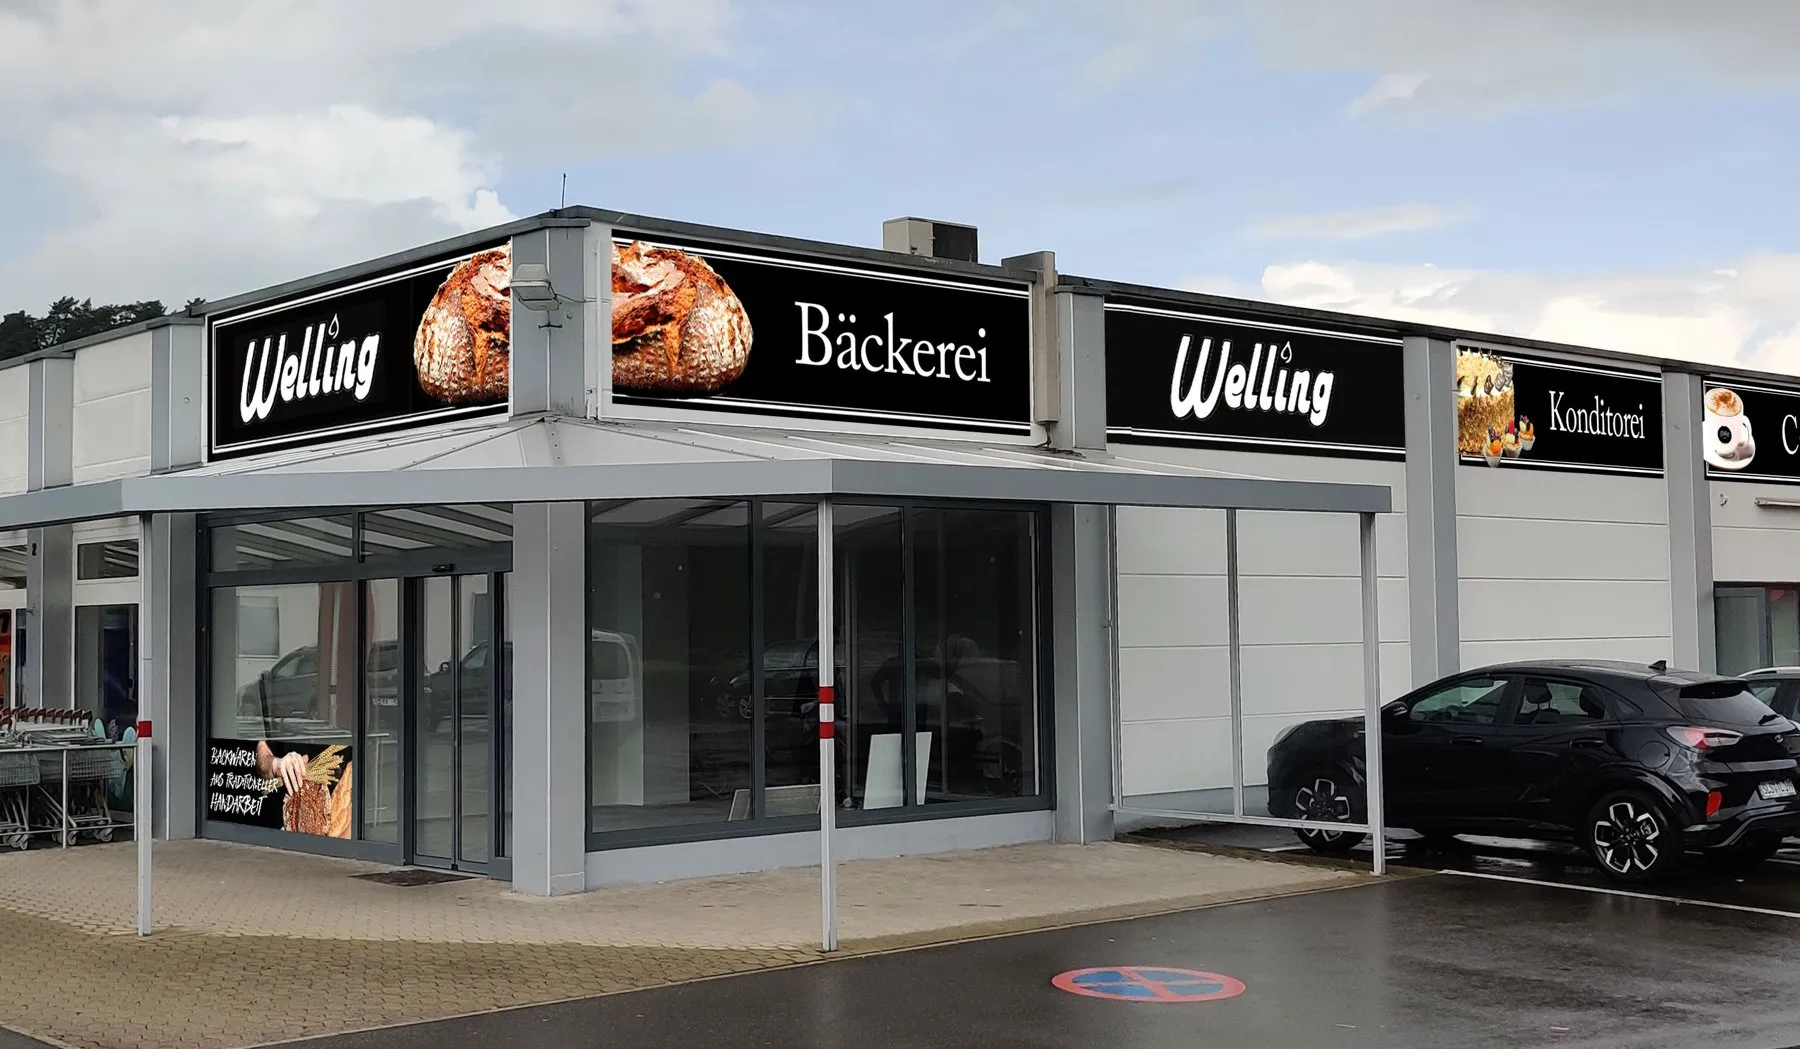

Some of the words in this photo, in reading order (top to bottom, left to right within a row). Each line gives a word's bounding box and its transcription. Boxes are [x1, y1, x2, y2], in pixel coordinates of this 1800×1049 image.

[240, 314, 381, 423] Welling
[794, 301, 991, 384] Bäckerei
[1170, 336, 1335, 427] Welling
[1548, 390, 1646, 440] Konditorei
[1781, 413, 1800, 455] C
[210, 792, 268, 816] HANDARBEIT
